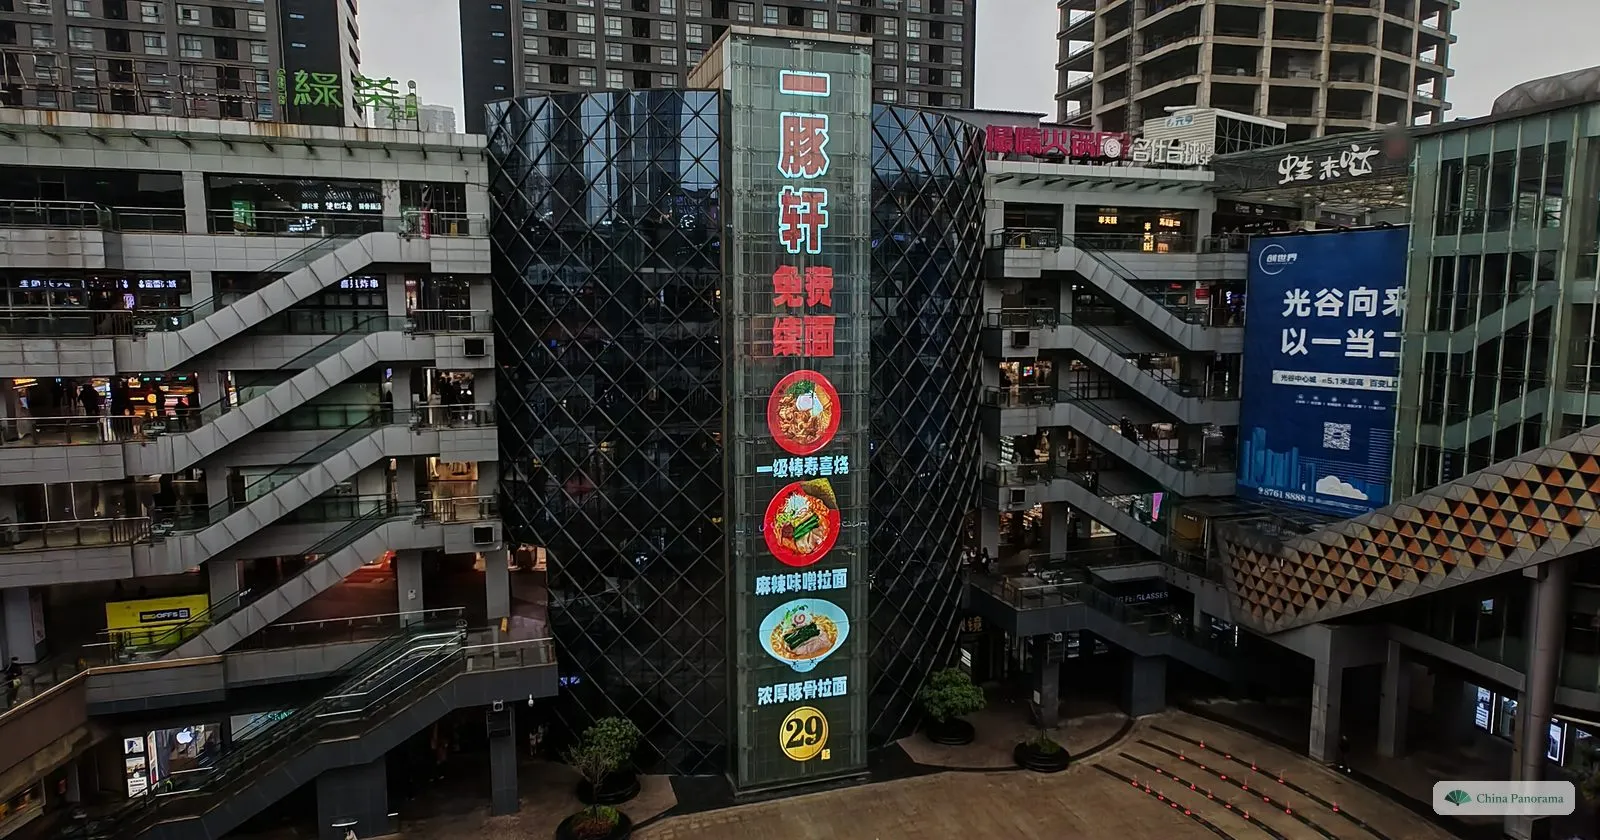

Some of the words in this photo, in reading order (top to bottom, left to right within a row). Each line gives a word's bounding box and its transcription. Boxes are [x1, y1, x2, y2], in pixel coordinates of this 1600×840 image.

[777, 69, 831, 254] 一豚轩
[1133, 137, 1200, 165] 名仕台球
[772, 265, 834, 308] 免费
[772, 315, 836, 357] 续面
[756, 455, 850, 478] 一级棒寿喜烧
[1263, 488, 1283, 499] 8761
[1285, 492, 1306, 502] 8888
[755, 567, 848, 596] 麻辣味噌拉面
[757, 676, 848, 706] 浓厚豚骨拉面
[785, 715, 824, 749] 29
